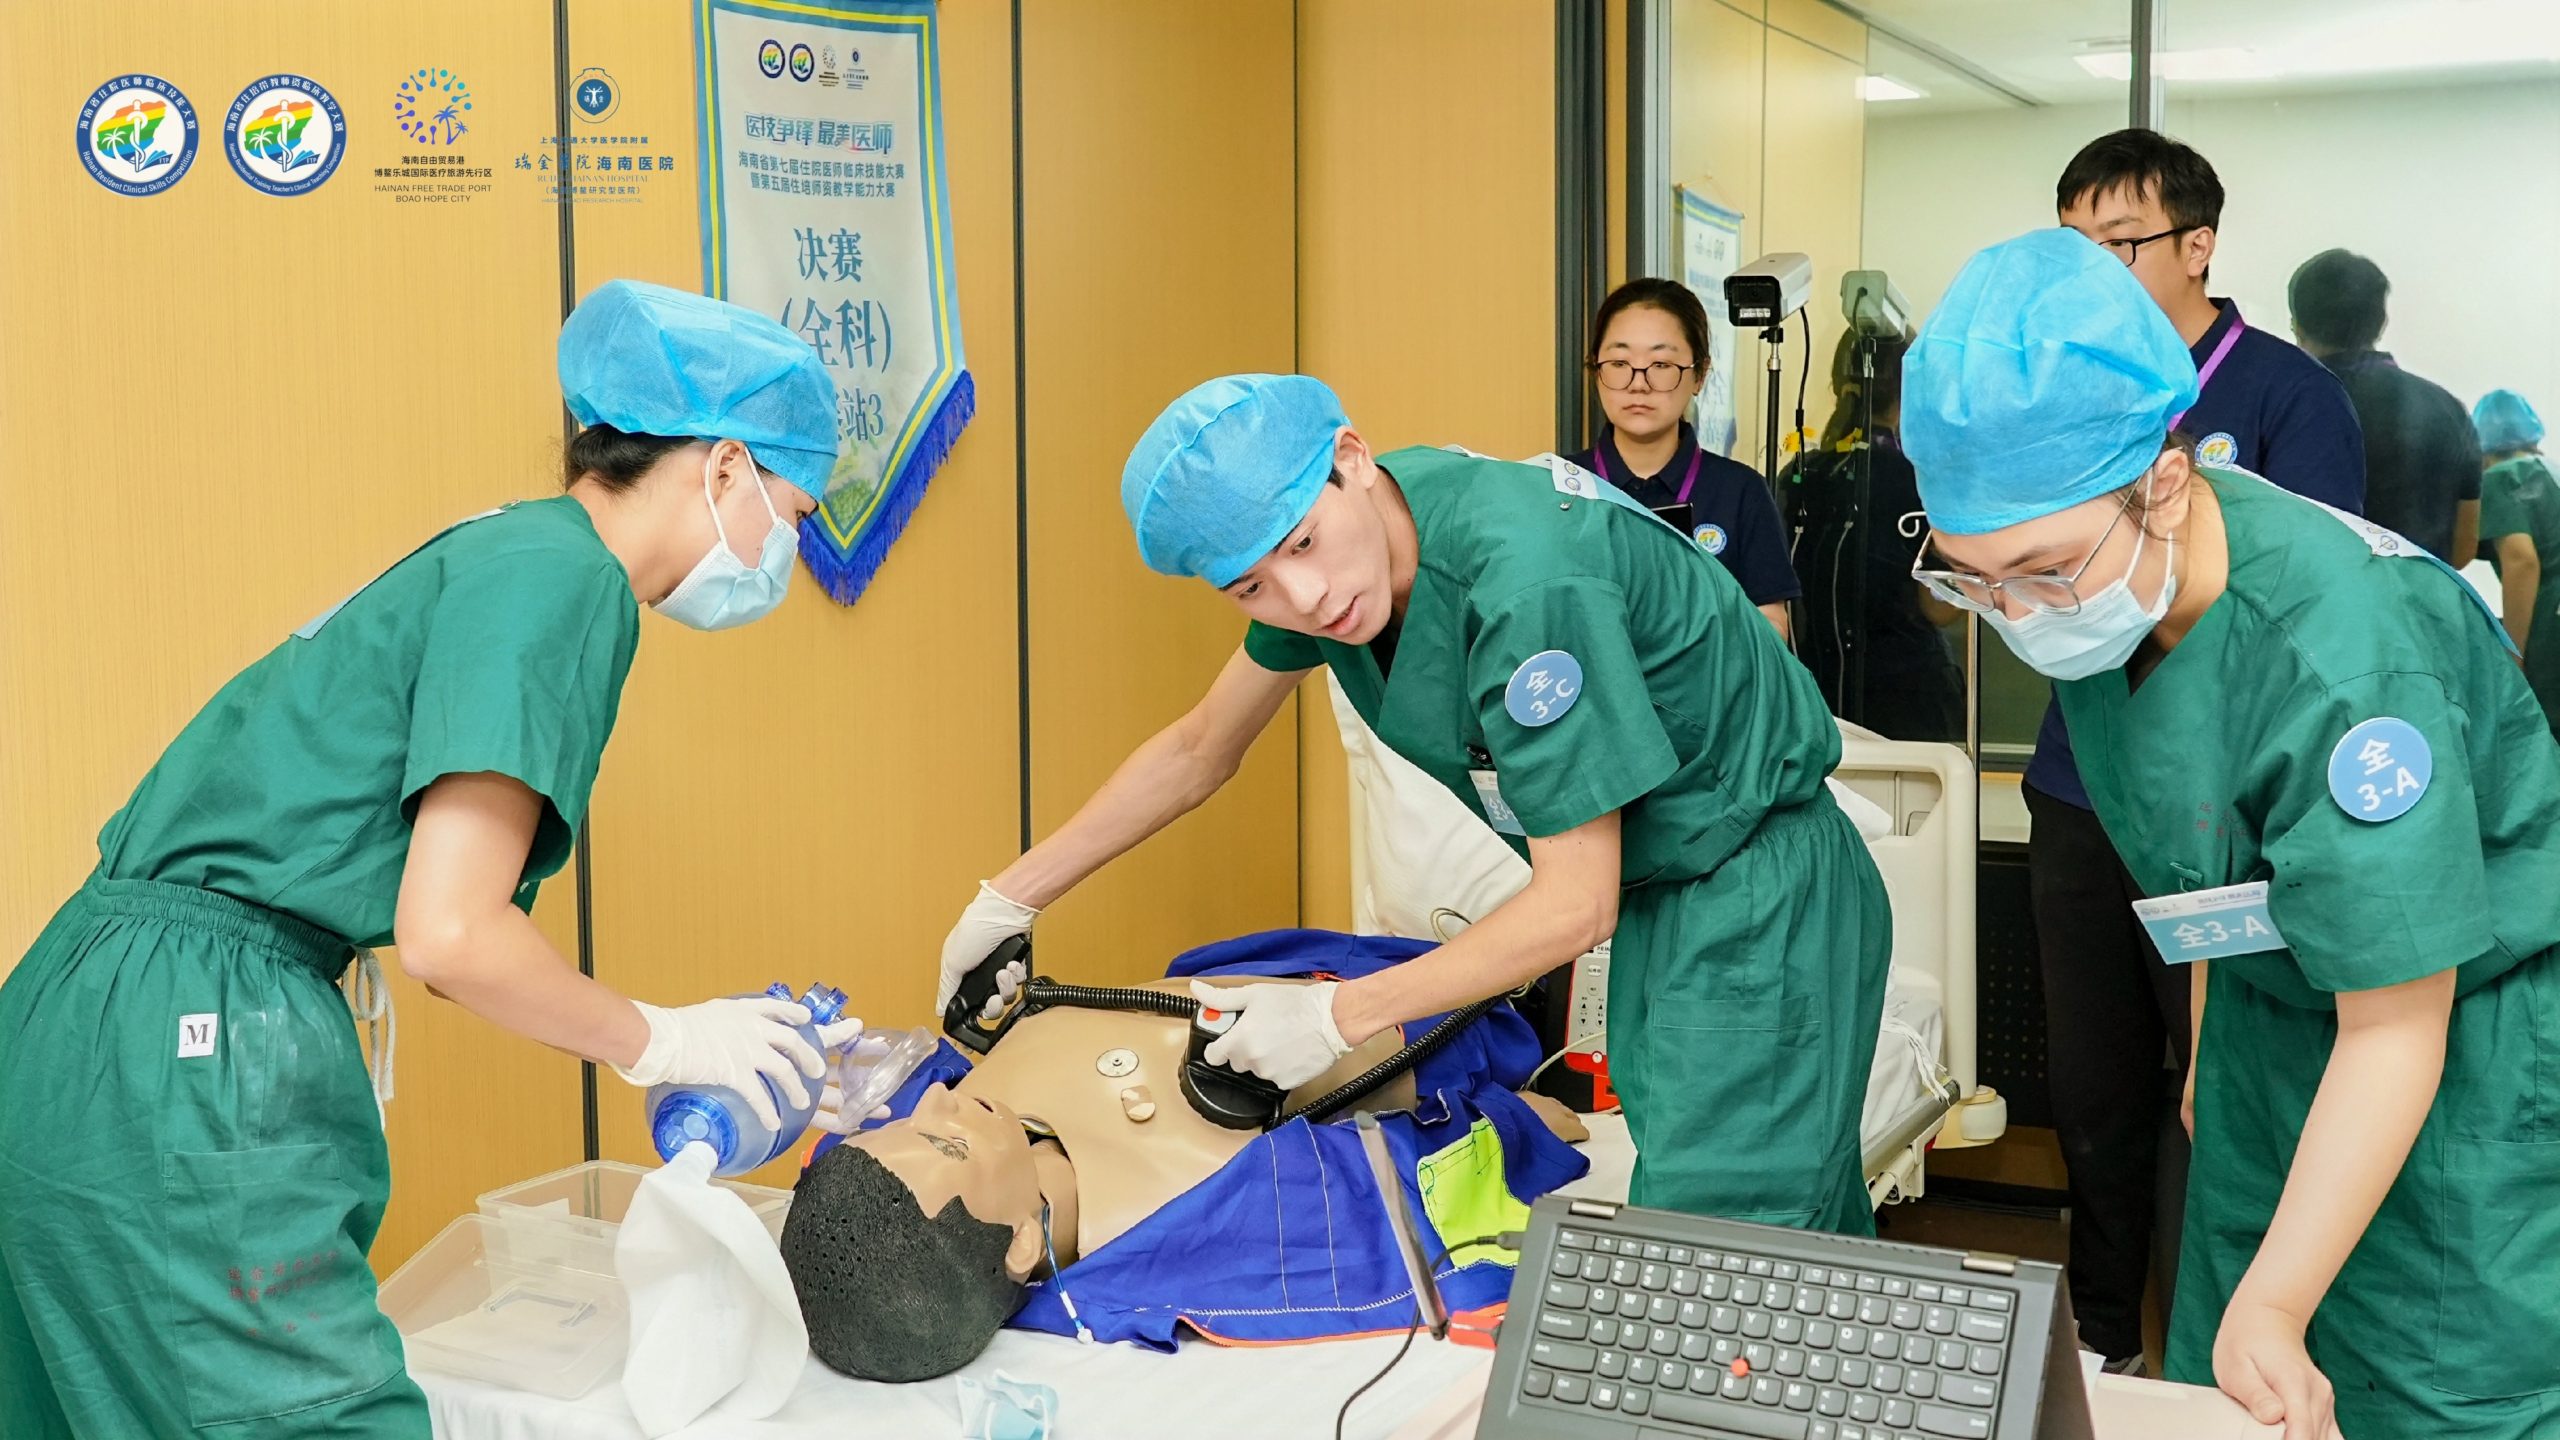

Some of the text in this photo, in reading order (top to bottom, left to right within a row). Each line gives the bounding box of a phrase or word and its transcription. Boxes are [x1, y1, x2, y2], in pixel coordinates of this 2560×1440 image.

[745, 113, 893, 155] 医技争锋 最美医师
[738, 151, 905, 180] 海南省第七届住院医师临床技能大赛
[750, 172, 896, 198] 暨第五届住培师资教学能力大赛
[793, 227, 864, 283] 决赛
[836, 385, 885, 441] 站3
[1526, 669, 1554, 697] 全
[1529, 677, 1575, 720] 3-C
[2357, 738, 2395, 776] 全
[2356, 766, 2421, 812] 3-A
[2172, 915, 2271, 949] 全3-A
[184, 1022, 210, 1047] M
